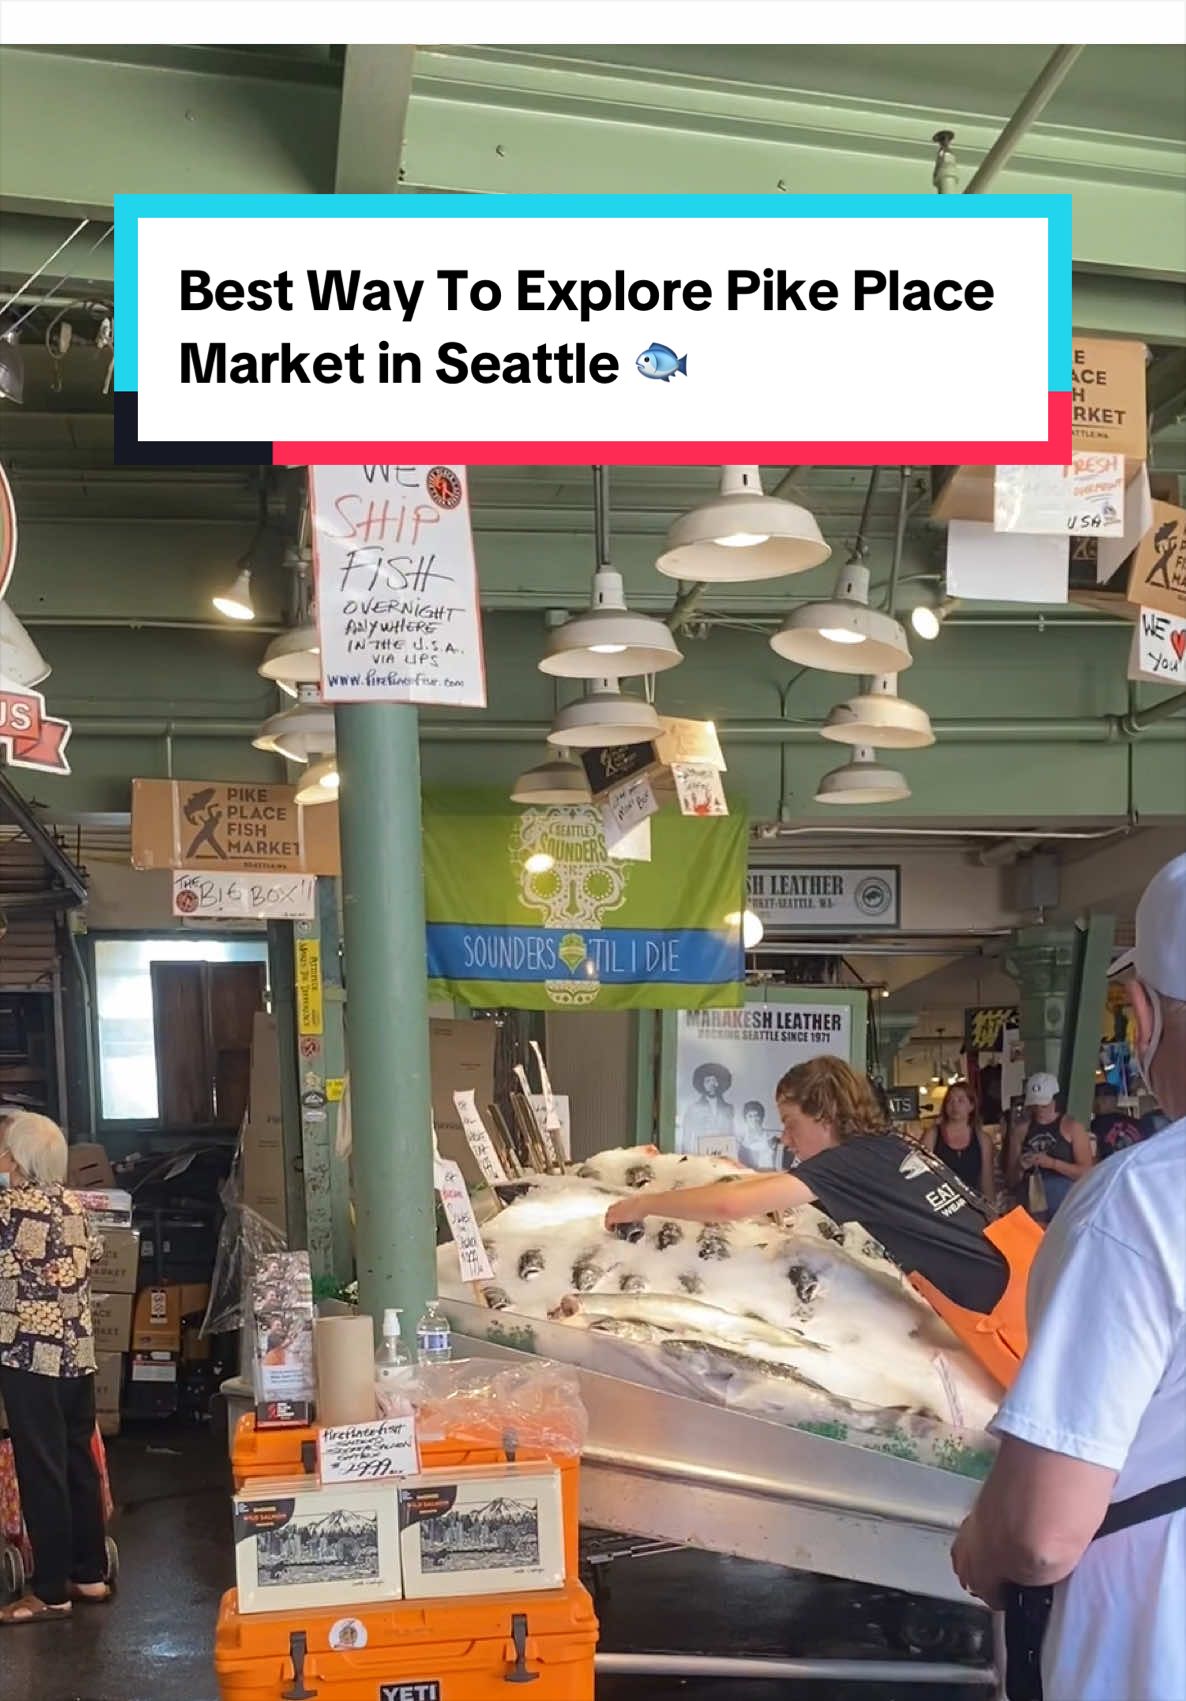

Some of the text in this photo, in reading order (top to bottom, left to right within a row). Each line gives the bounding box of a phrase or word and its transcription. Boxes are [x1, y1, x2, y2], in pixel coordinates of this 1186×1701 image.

[335, 546, 454, 592] FISH
[343, 597, 467, 622] OVERNIGHT
[345, 618, 443, 638] ANYWHERE
[1142, 613, 1171, 640] WE
[347, 639, 366, 653] IN
[373, 653, 439, 668] VIA UPS
[227, 787, 269, 803] PIKE
[227, 805, 288, 821] PLACE
[227, 822, 267, 837] FISH
[555, 824, 590, 838] SEATTLE
[227, 840, 300, 856] MARKET
[541, 832, 609, 863] SOUNDERS
[175, 874, 201, 889] THE
[771, 875, 845, 895] LEATHER
[463, 935, 556, 970] SOUNDERS
[646, 939, 680, 973] DIE
[686, 1010, 842, 1031] MARAKESH LEATHER
[742, 1030, 779, 1041] SEATTLE
[781, 1031, 808, 1042] SINCE
[810, 1032, 831, 1043] 1971
[925, 1182, 956, 1207] EAT
[383, 1685, 436, 1701] YETI
